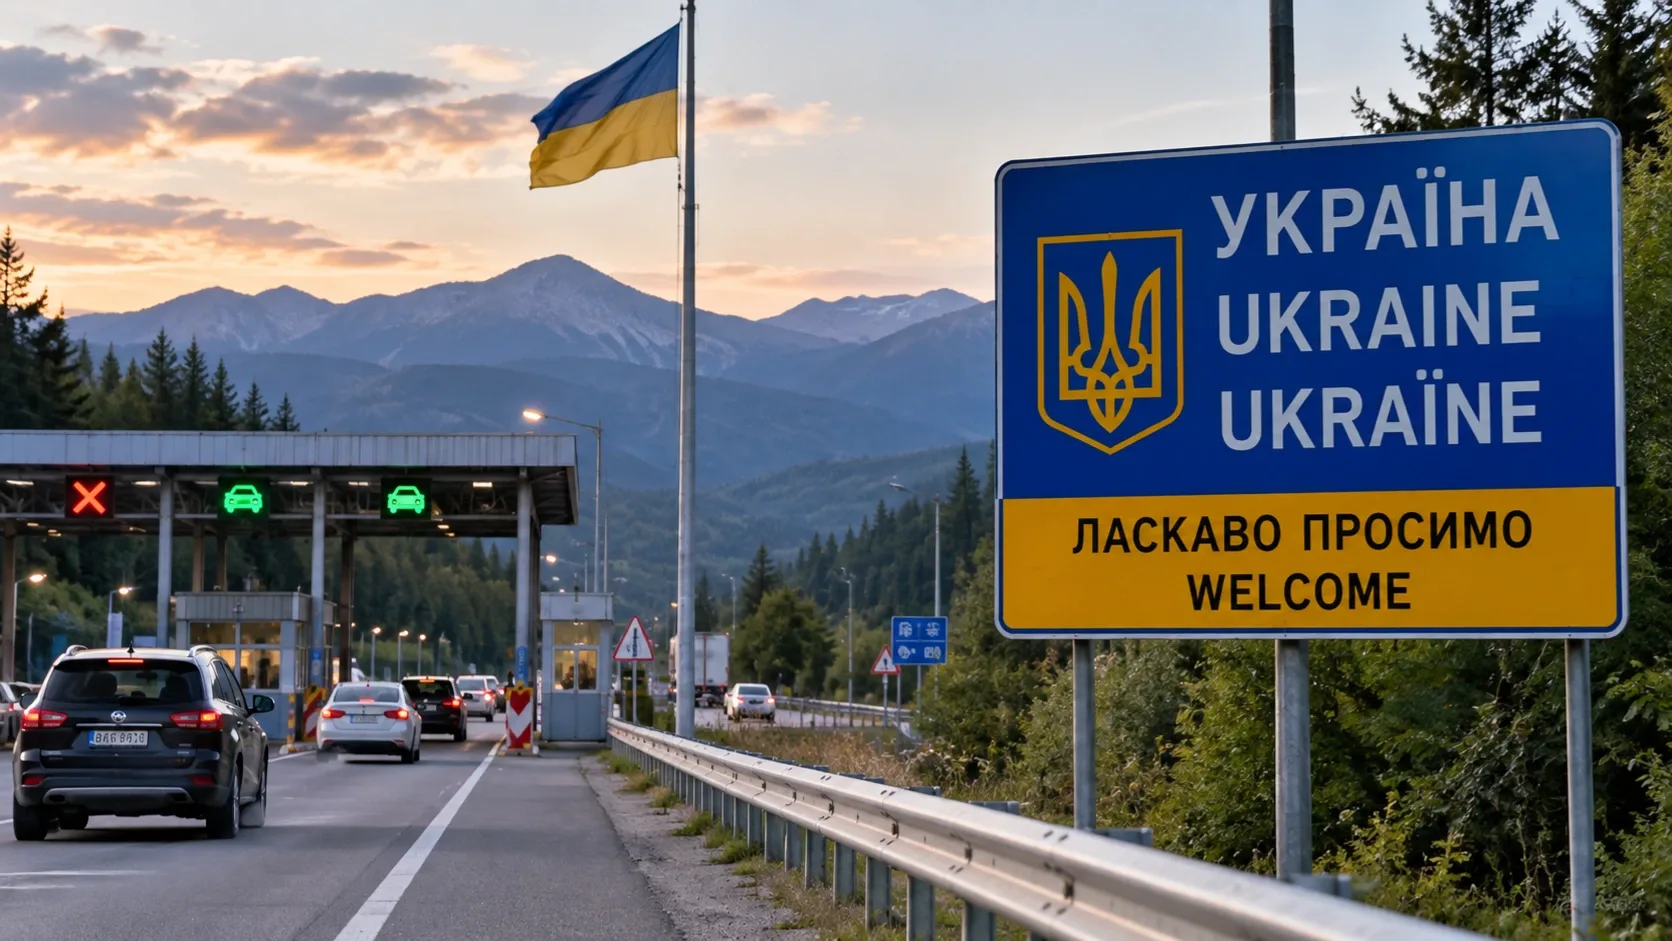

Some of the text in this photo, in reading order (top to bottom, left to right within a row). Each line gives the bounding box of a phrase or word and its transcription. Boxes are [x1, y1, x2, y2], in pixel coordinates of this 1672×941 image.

[1210, 166, 1560, 259] УКРАЇНА
[1218, 280, 1541, 355] UKRAINE
[1221, 368, 1542, 451] UKRAÏNE
[1072, 510, 1532, 554] ЛАСКАВО ПРОСИМО
[1187, 572, 1411, 611] WELCOME
